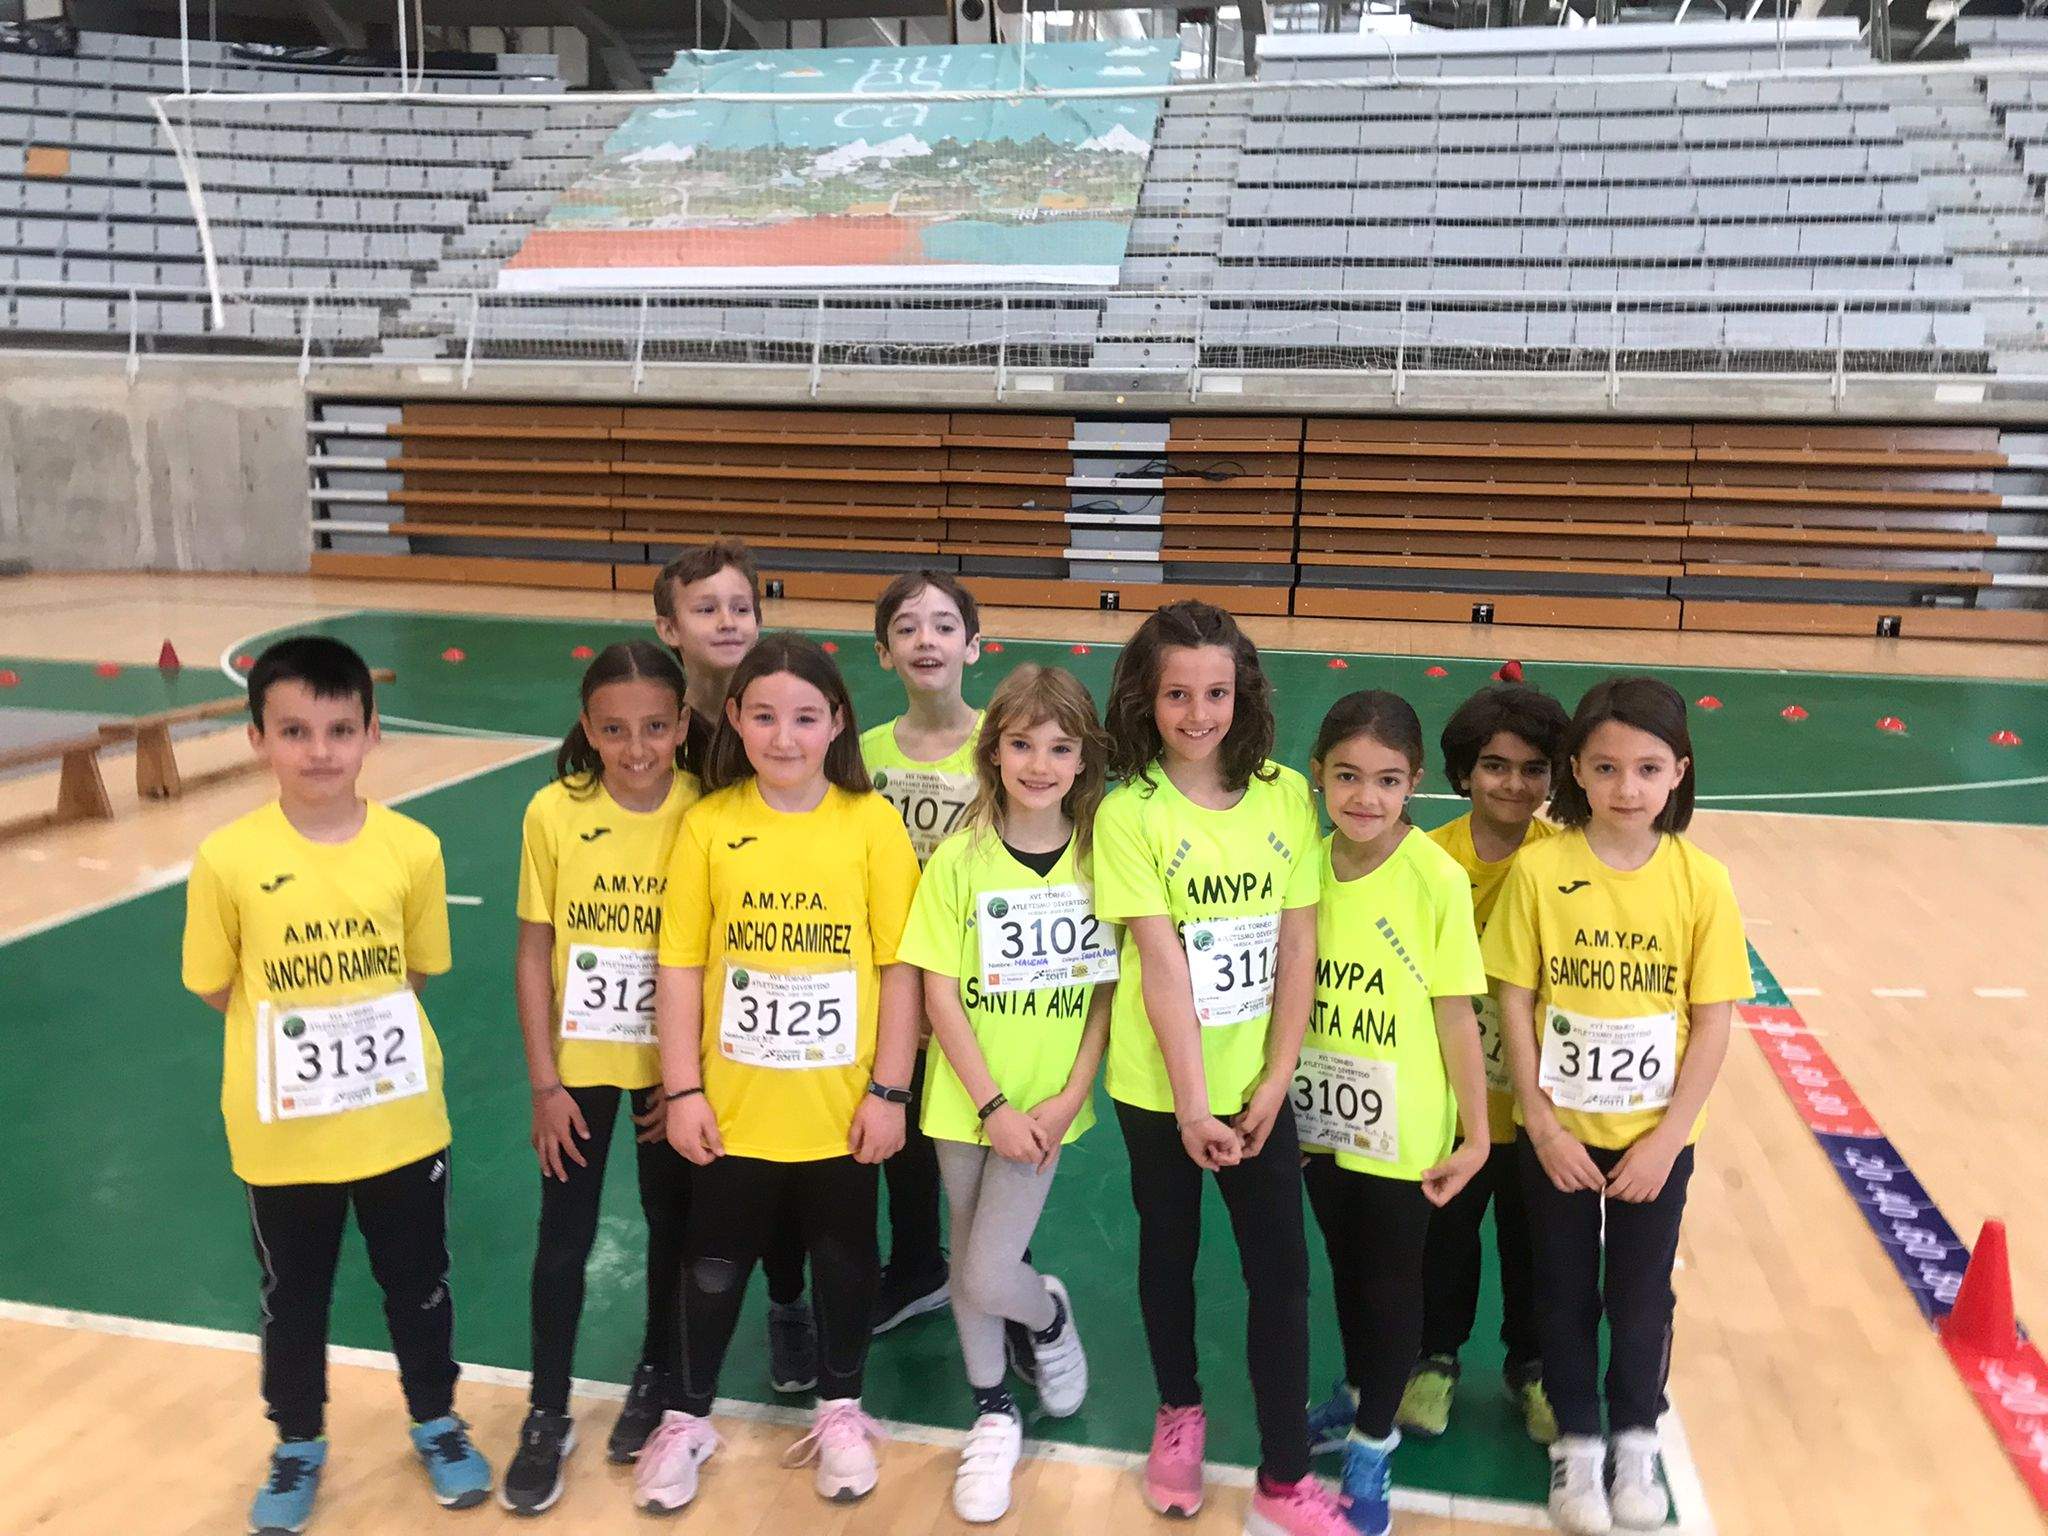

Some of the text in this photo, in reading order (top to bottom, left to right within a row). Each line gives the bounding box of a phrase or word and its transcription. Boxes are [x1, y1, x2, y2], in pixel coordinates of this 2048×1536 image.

[742, 890, 828, 911] A.M.Y.P.A.
[1187, 871, 1272, 904] AMYPA
[567, 899, 629, 933] SANCHO
[723, 920, 852, 955] ANCHO RAMIREZ
[1001, 914, 1100, 959] 3102
[1574, 928, 1663, 952] A.M.Y.P.A.
[1550, 955, 1678, 996] SANCHO RAMIRE
[738, 995, 842, 1037] 3125
[1046, 986, 1085, 1019] ANA
[1352, 1008, 1396, 1048] ANA
[297, 1026, 407, 1083] 3132
[1559, 1041, 1661, 1083] 3126
[1294, 1075, 1383, 1126] 3109
